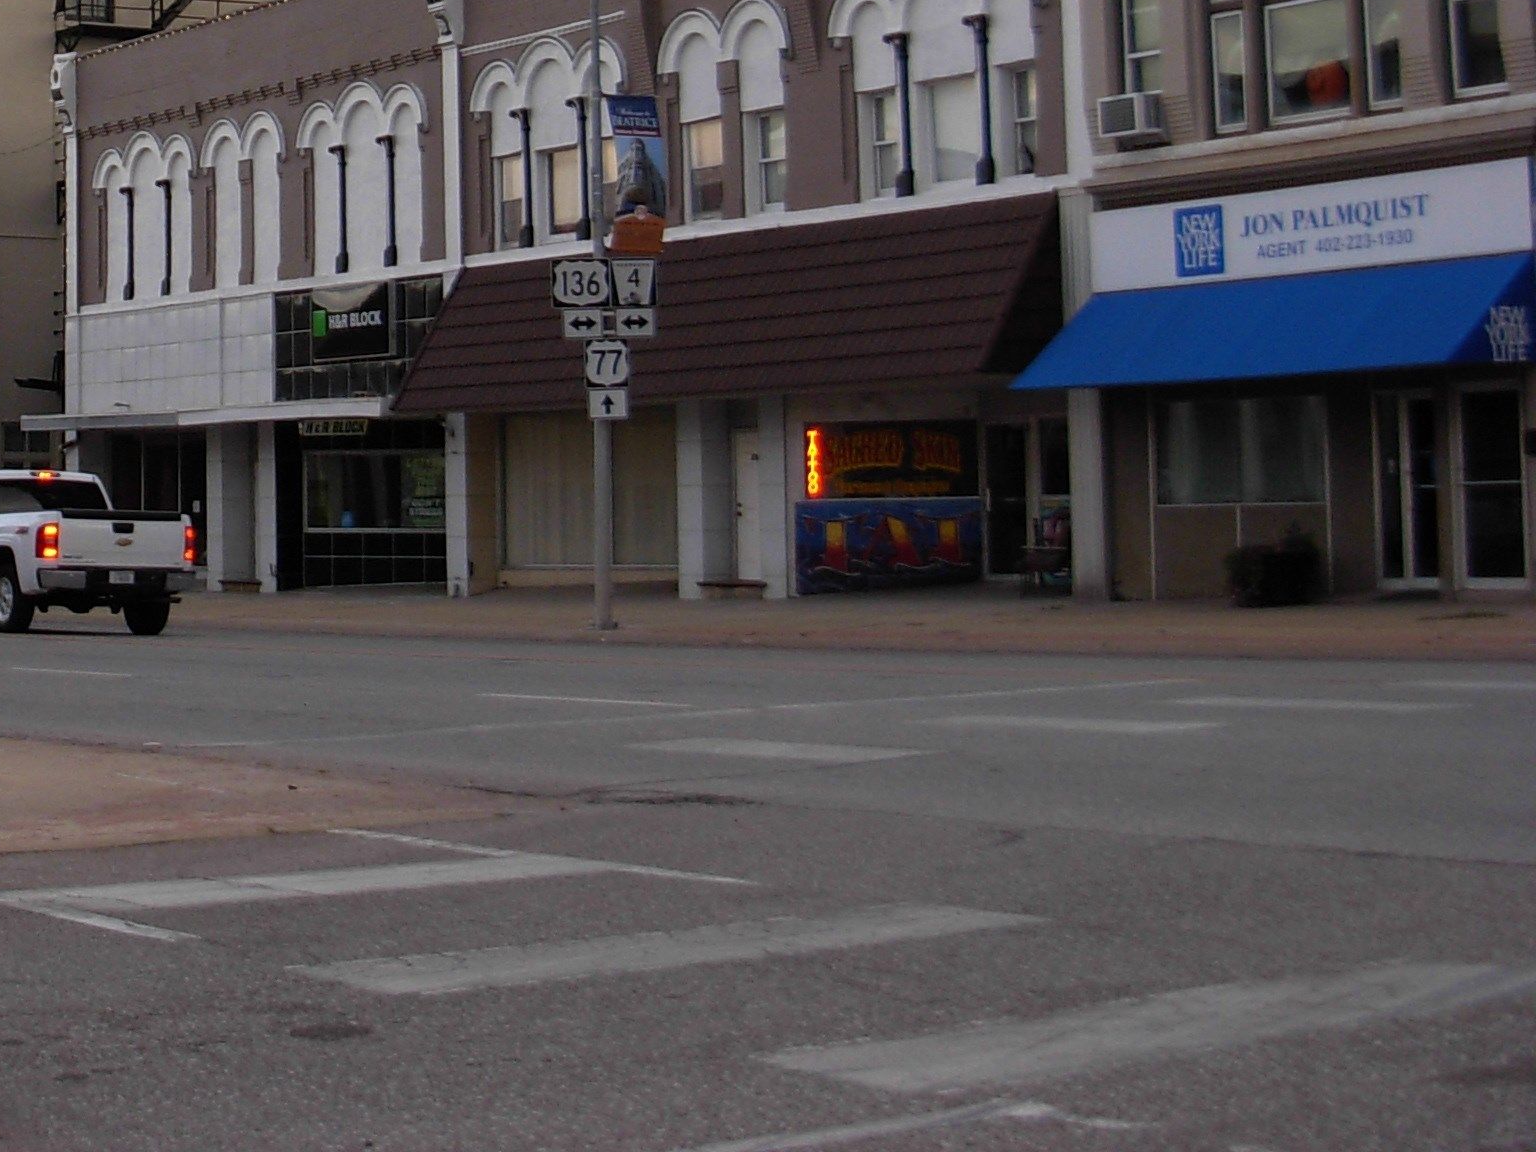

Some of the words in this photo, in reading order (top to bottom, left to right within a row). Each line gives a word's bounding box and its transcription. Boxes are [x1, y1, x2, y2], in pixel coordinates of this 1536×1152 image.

[1181, 211, 1217, 234] NEW
[1240, 213, 1284, 238] JON
[1292, 193, 1430, 231] PALMQUIST
[1176, 229, 1222, 252] YORK
[1257, 239, 1306, 259] AGENT
[1183, 246, 1218, 269] LIFE
[561, 270, 601, 297] 136
[626, 267, 641, 288] 4
[349, 310, 383, 327] BLOCK
[590, 349, 624, 376] 77
[332, 419, 364, 434] BLOCK
